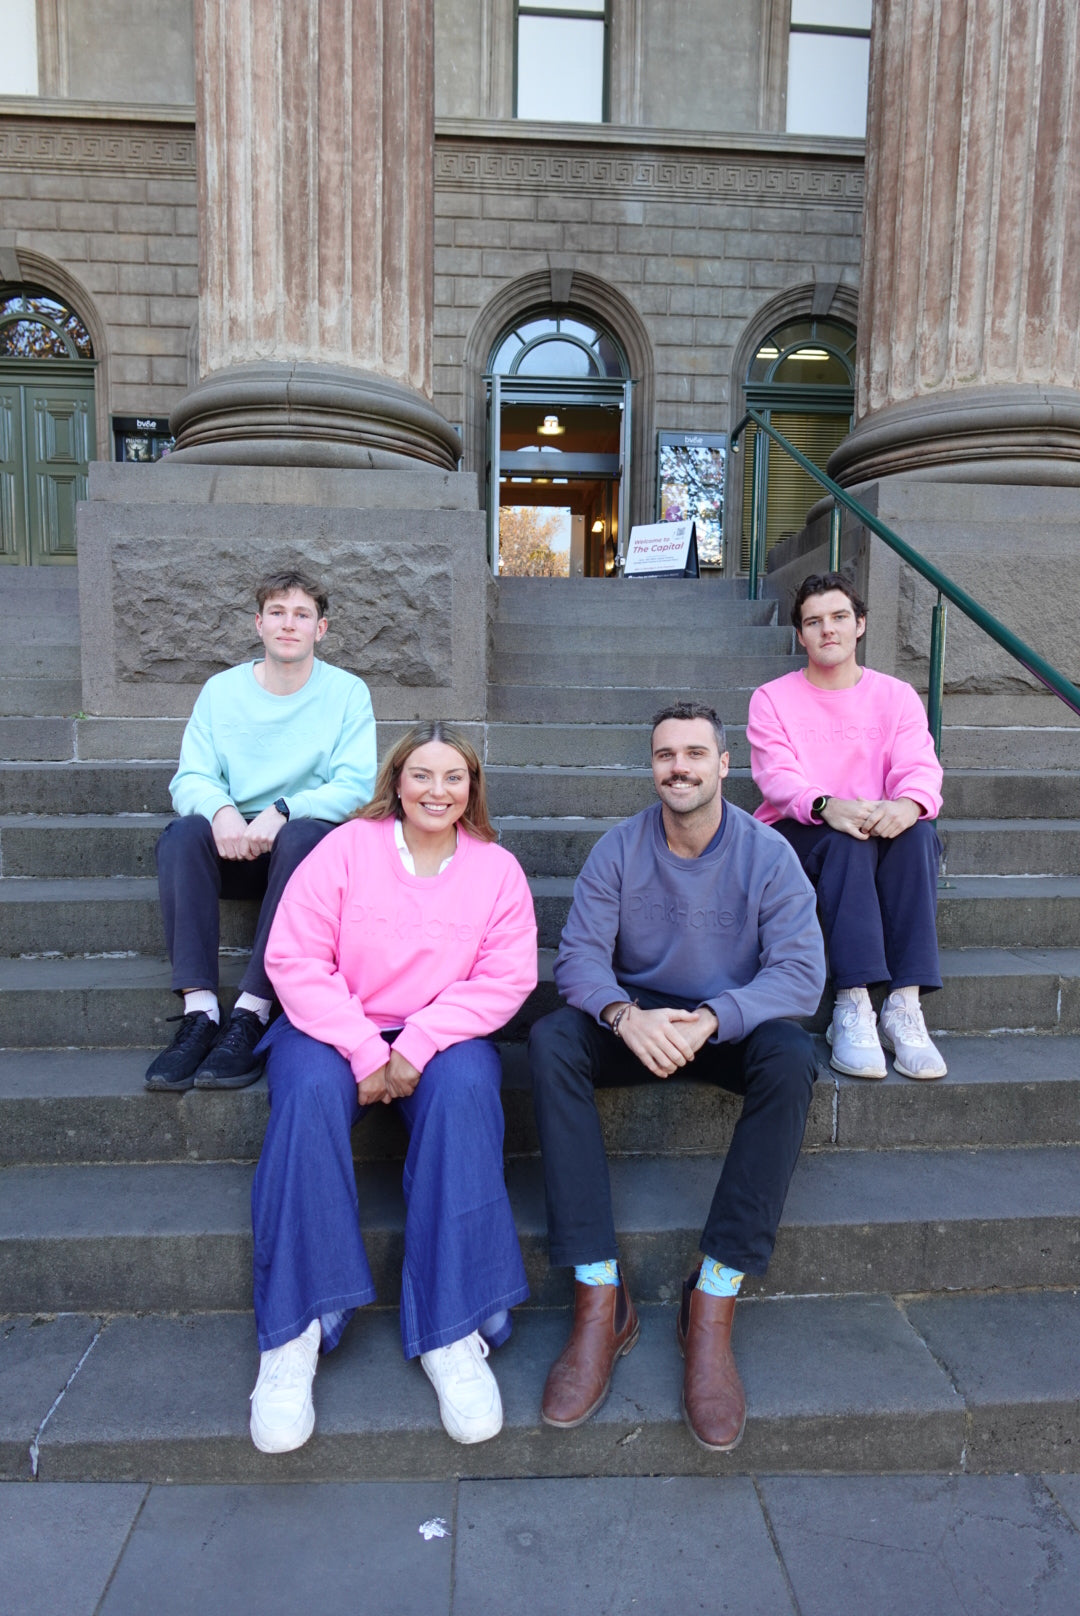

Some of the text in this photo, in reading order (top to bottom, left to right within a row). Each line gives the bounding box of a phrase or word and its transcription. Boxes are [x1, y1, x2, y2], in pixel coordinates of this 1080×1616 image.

[634, 537, 662, 545] Welcome
[633, 541, 685, 554] The Capital
